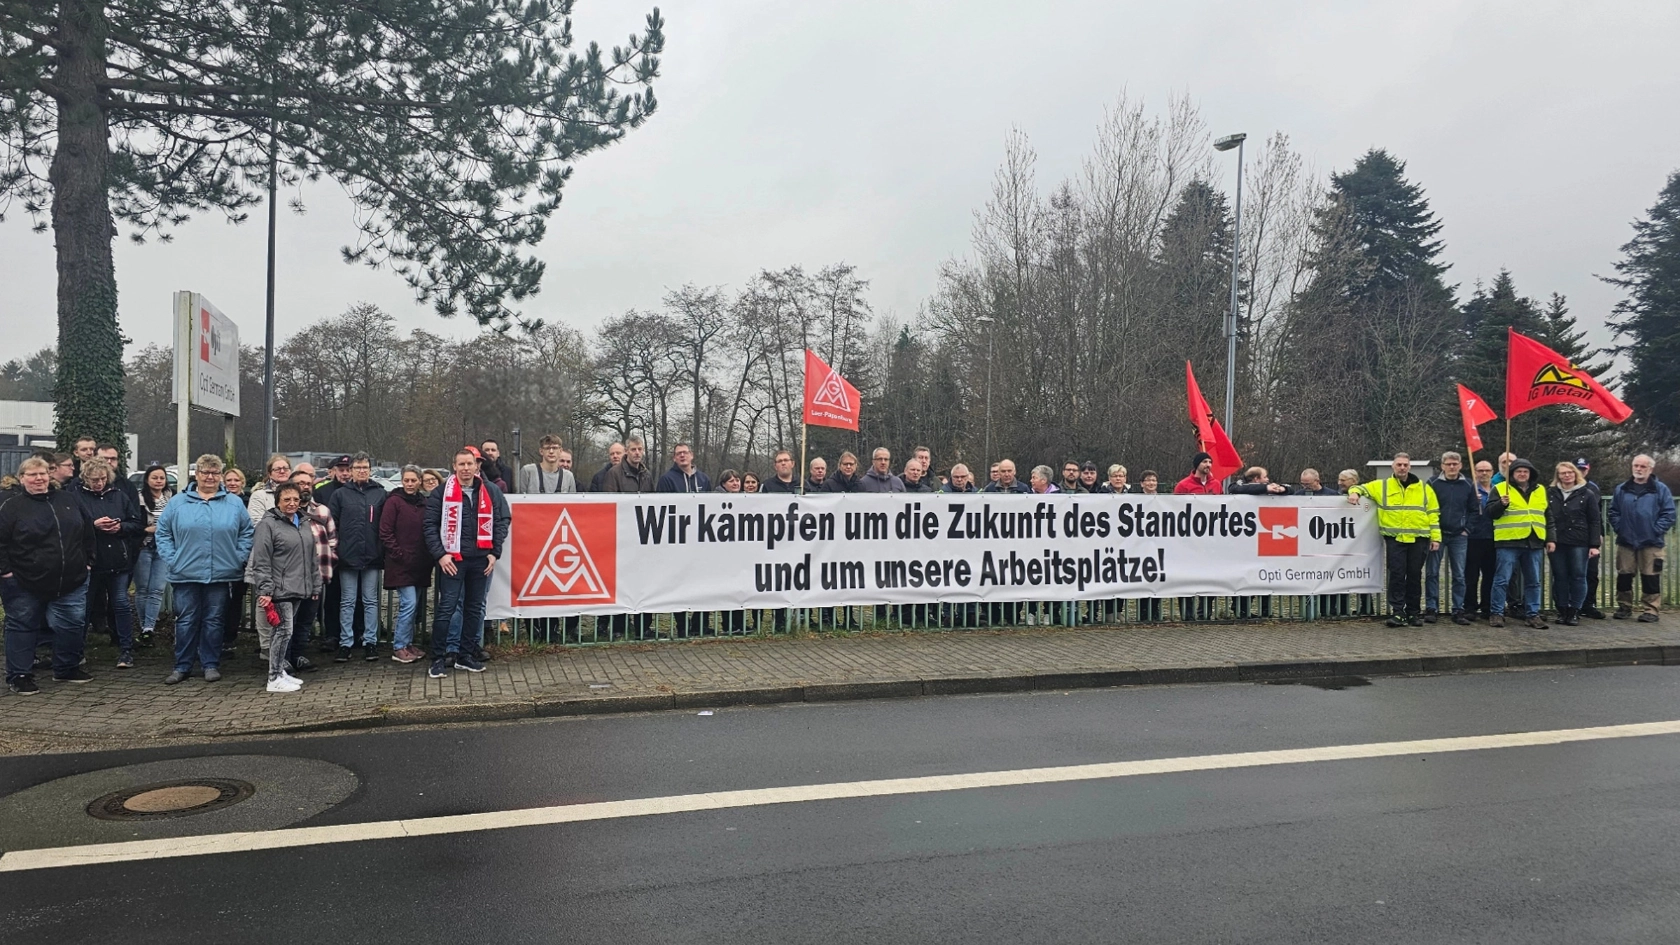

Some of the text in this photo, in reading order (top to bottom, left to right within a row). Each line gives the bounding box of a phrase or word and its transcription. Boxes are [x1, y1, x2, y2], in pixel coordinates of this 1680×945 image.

[1527, 384, 1594, 402] IG Metall
[448, 505, 458, 534] WIR
[635, 503, 1257, 550] Wir kämpfen um die Zukunft des Standortes
[1309, 515, 1356, 545] Opti
[755, 547, 1166, 593] und um unsere Arbeitsplätze!
[1258, 567, 1371, 583] Opti Germany GmbH
